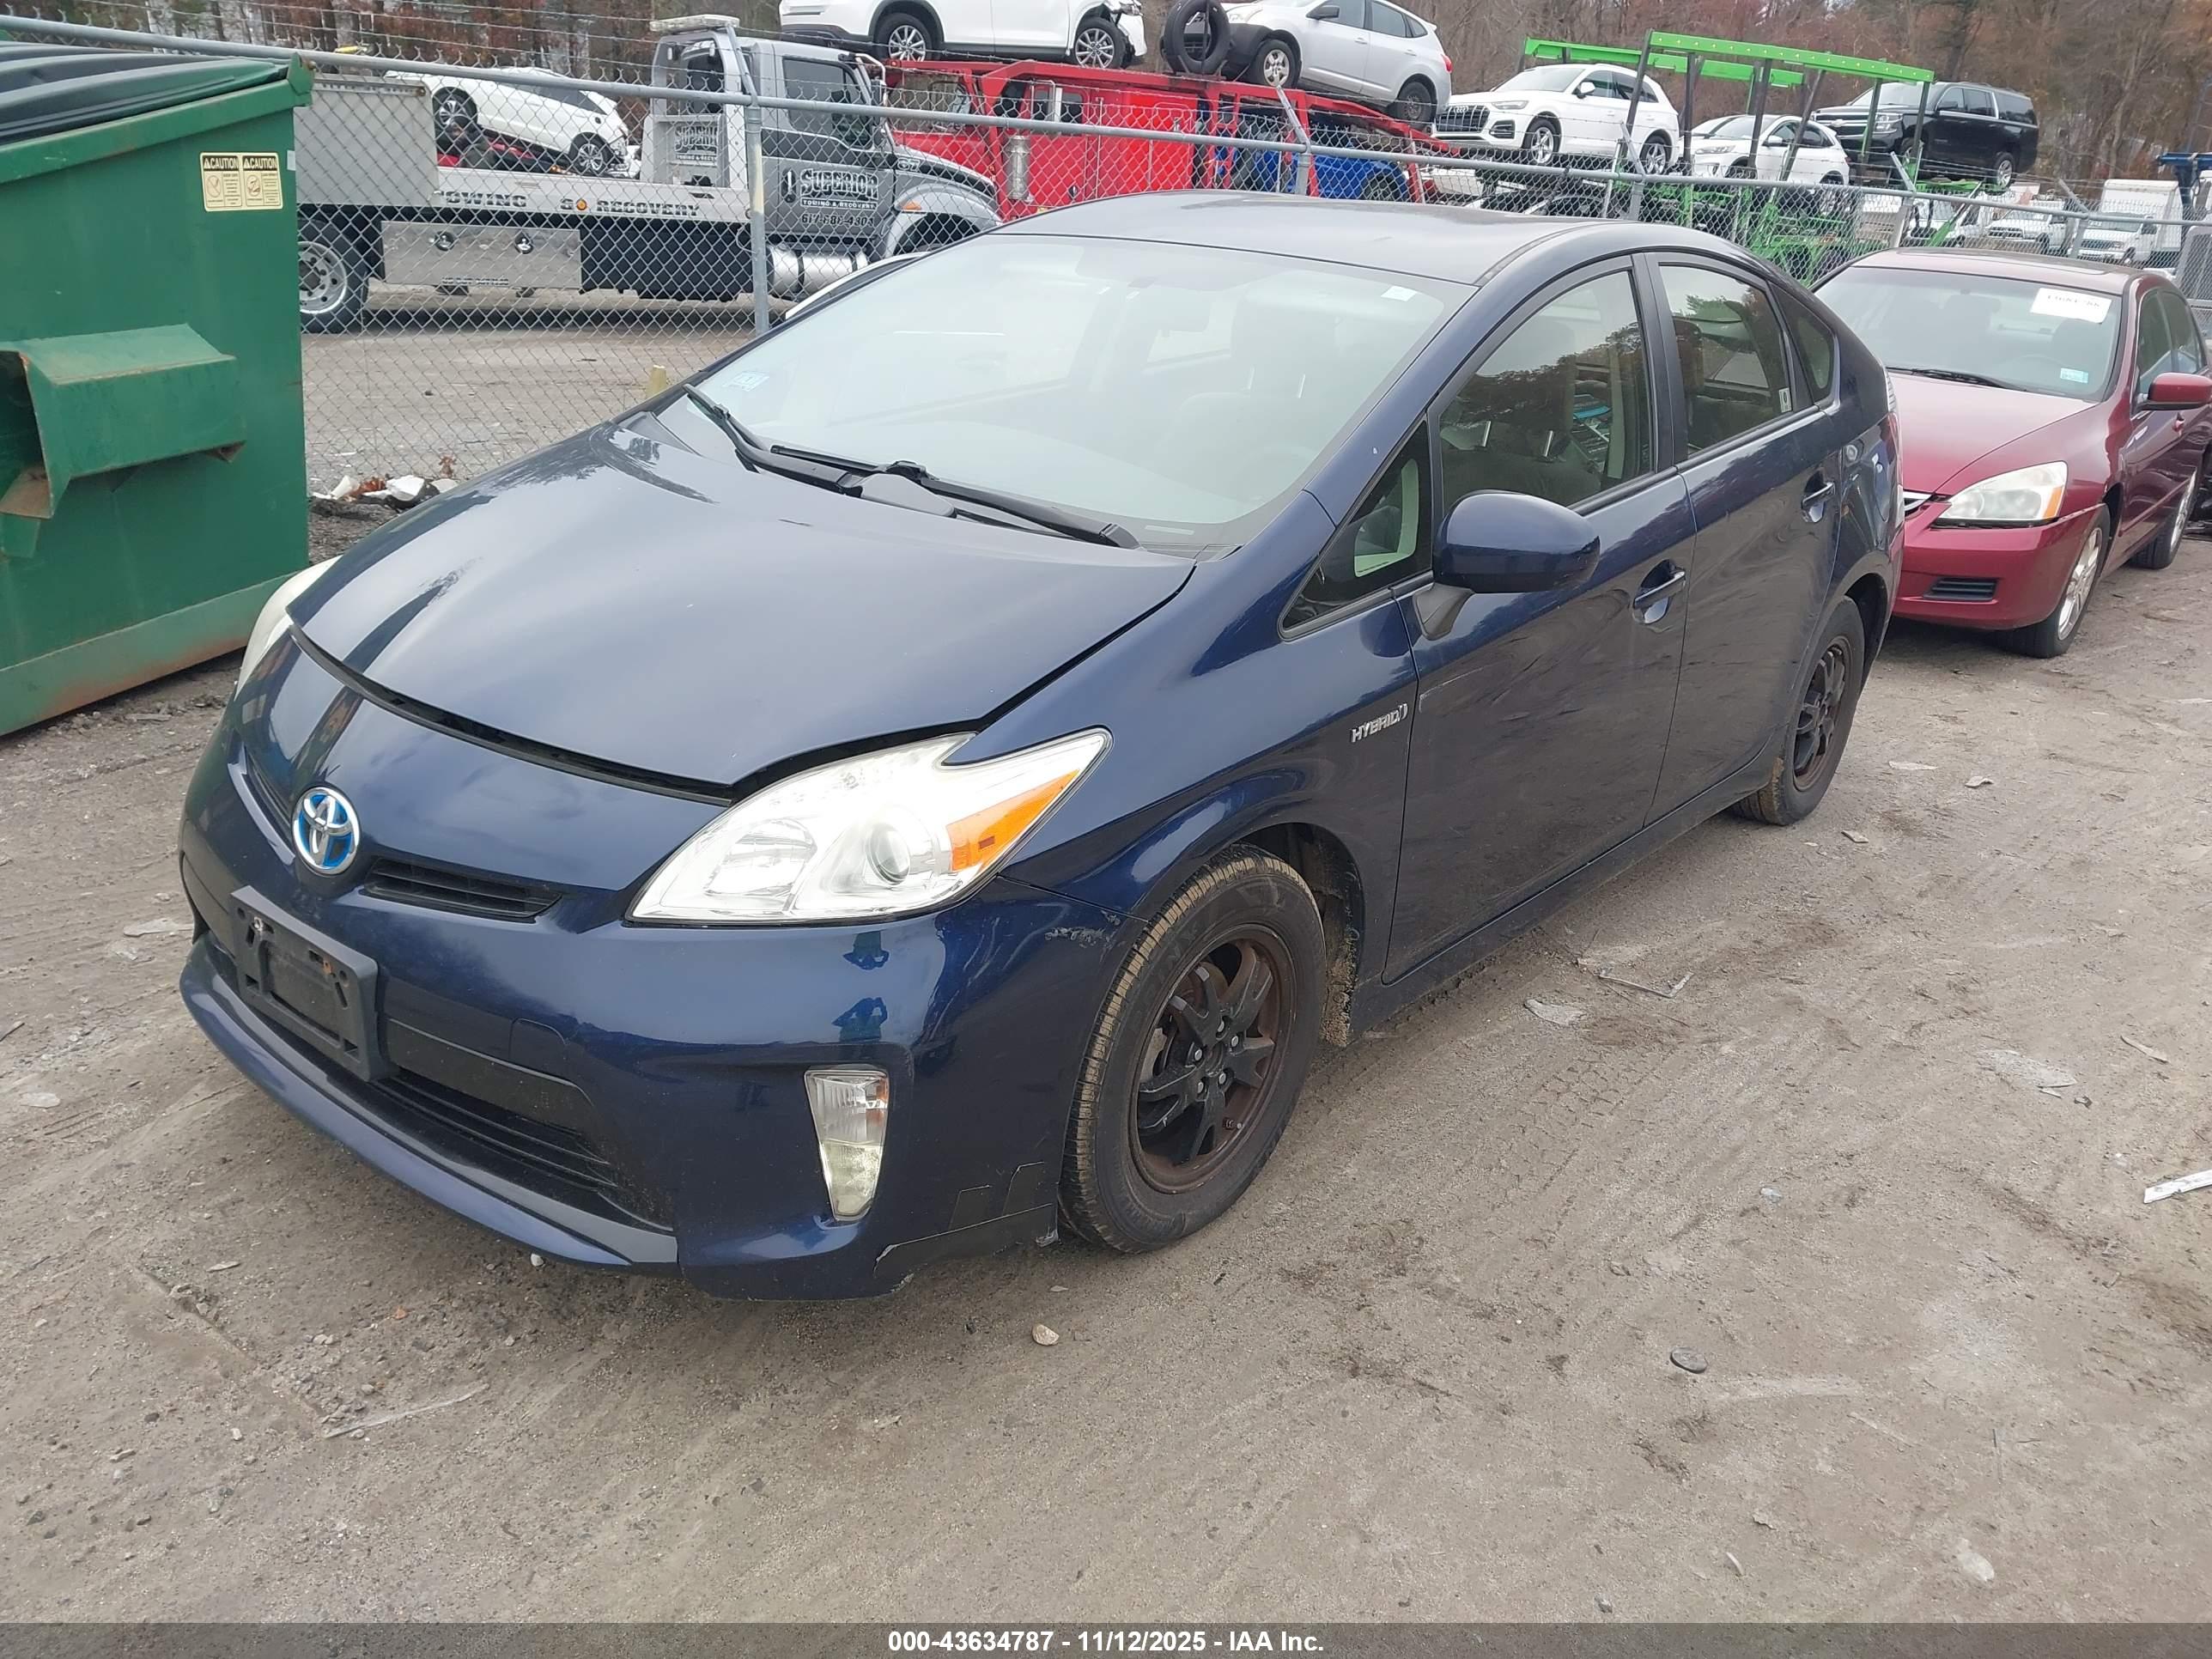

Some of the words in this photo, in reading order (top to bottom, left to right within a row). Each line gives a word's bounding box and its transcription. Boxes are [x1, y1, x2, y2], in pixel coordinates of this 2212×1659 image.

[210, 157, 239, 169] CAUTION
[250, 157, 277, 169] CAUTION
[799, 168, 879, 200] SUPERIOR
[596, 200, 700, 216] RECOVERY
[839, 201, 877, 210] RECOVERY
[1352, 708, 1401, 743] HYBRID
